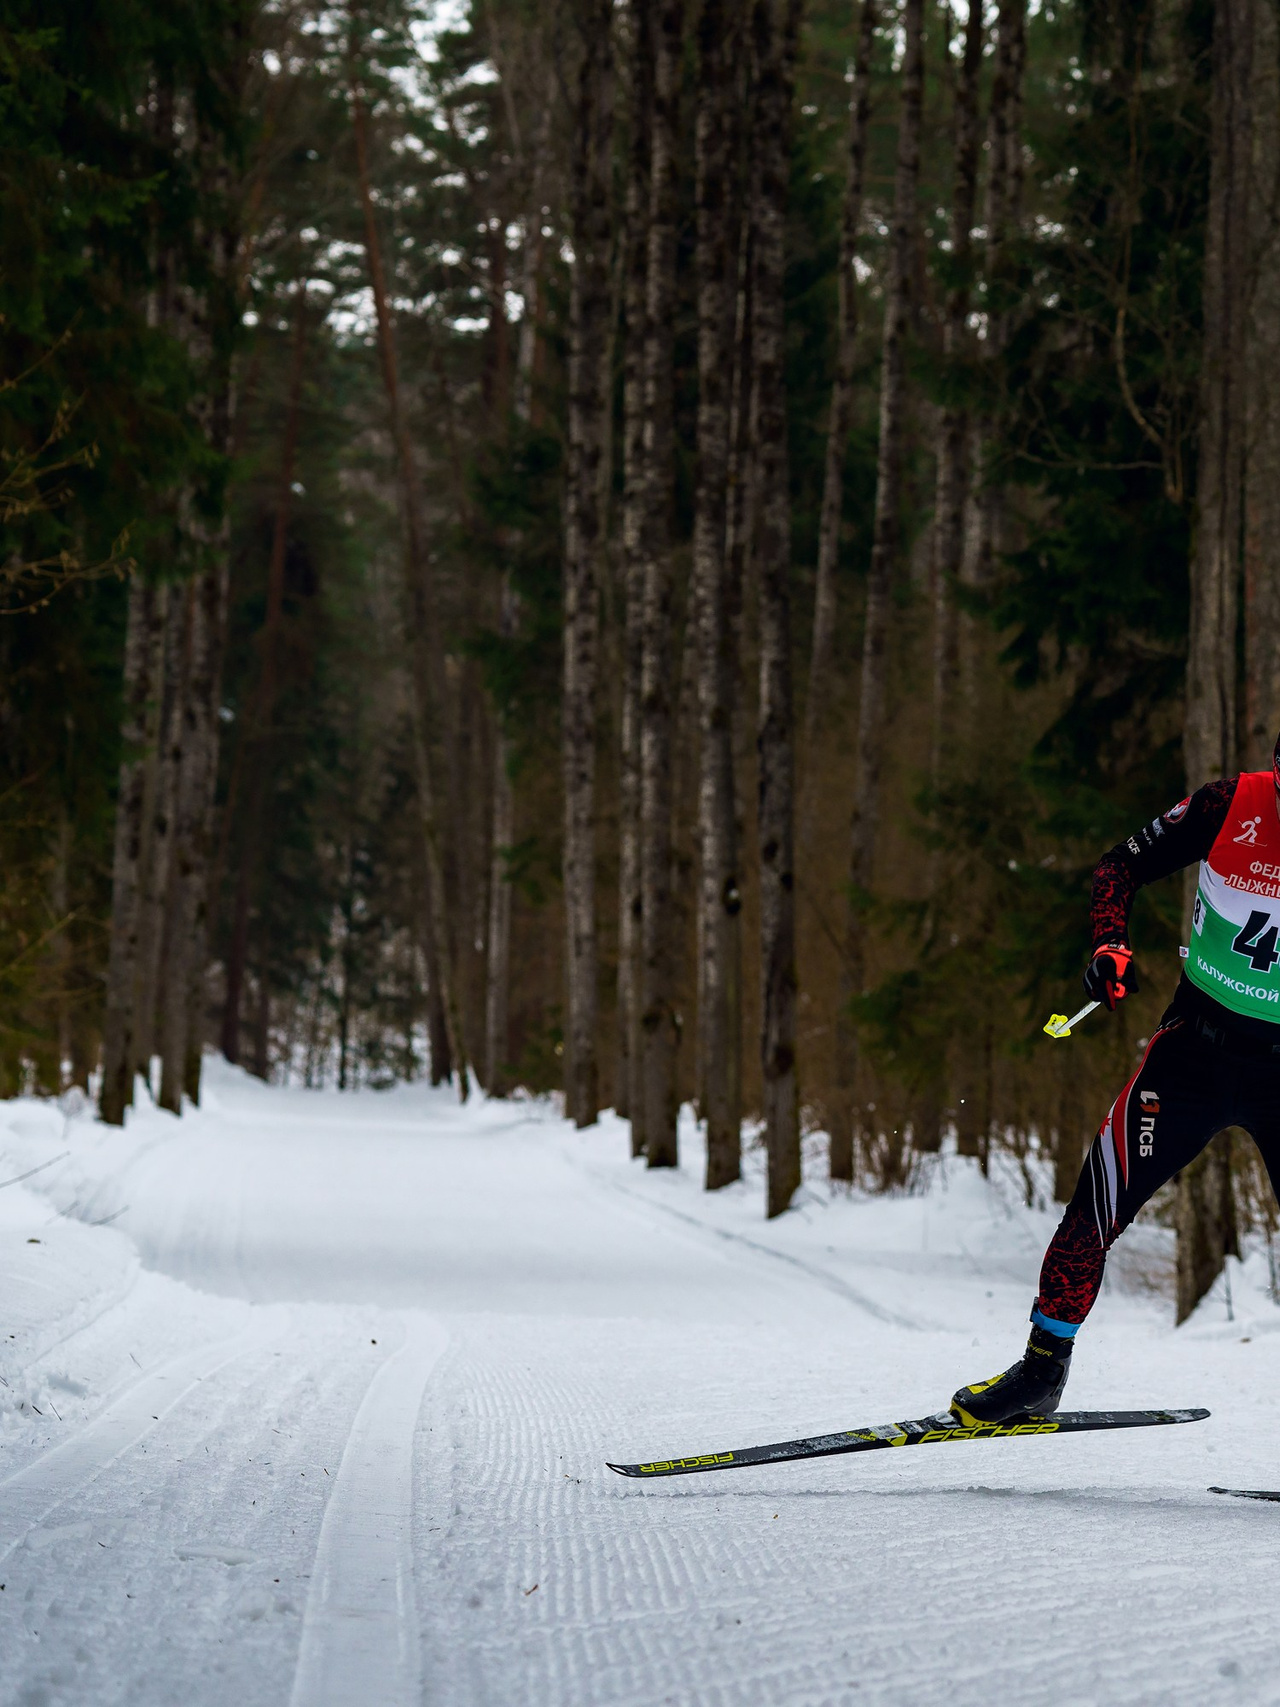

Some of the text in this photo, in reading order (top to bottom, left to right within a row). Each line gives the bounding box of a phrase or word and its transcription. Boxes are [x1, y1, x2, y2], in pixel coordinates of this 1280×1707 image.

[1196, 955, 1280, 1004] КАЛУЖСКОЙ
[1139, 1117, 1156, 1157] ПСБ
[918, 1423, 1060, 1444] FISCHER
[638, 1452, 735, 1473] FISCHER
